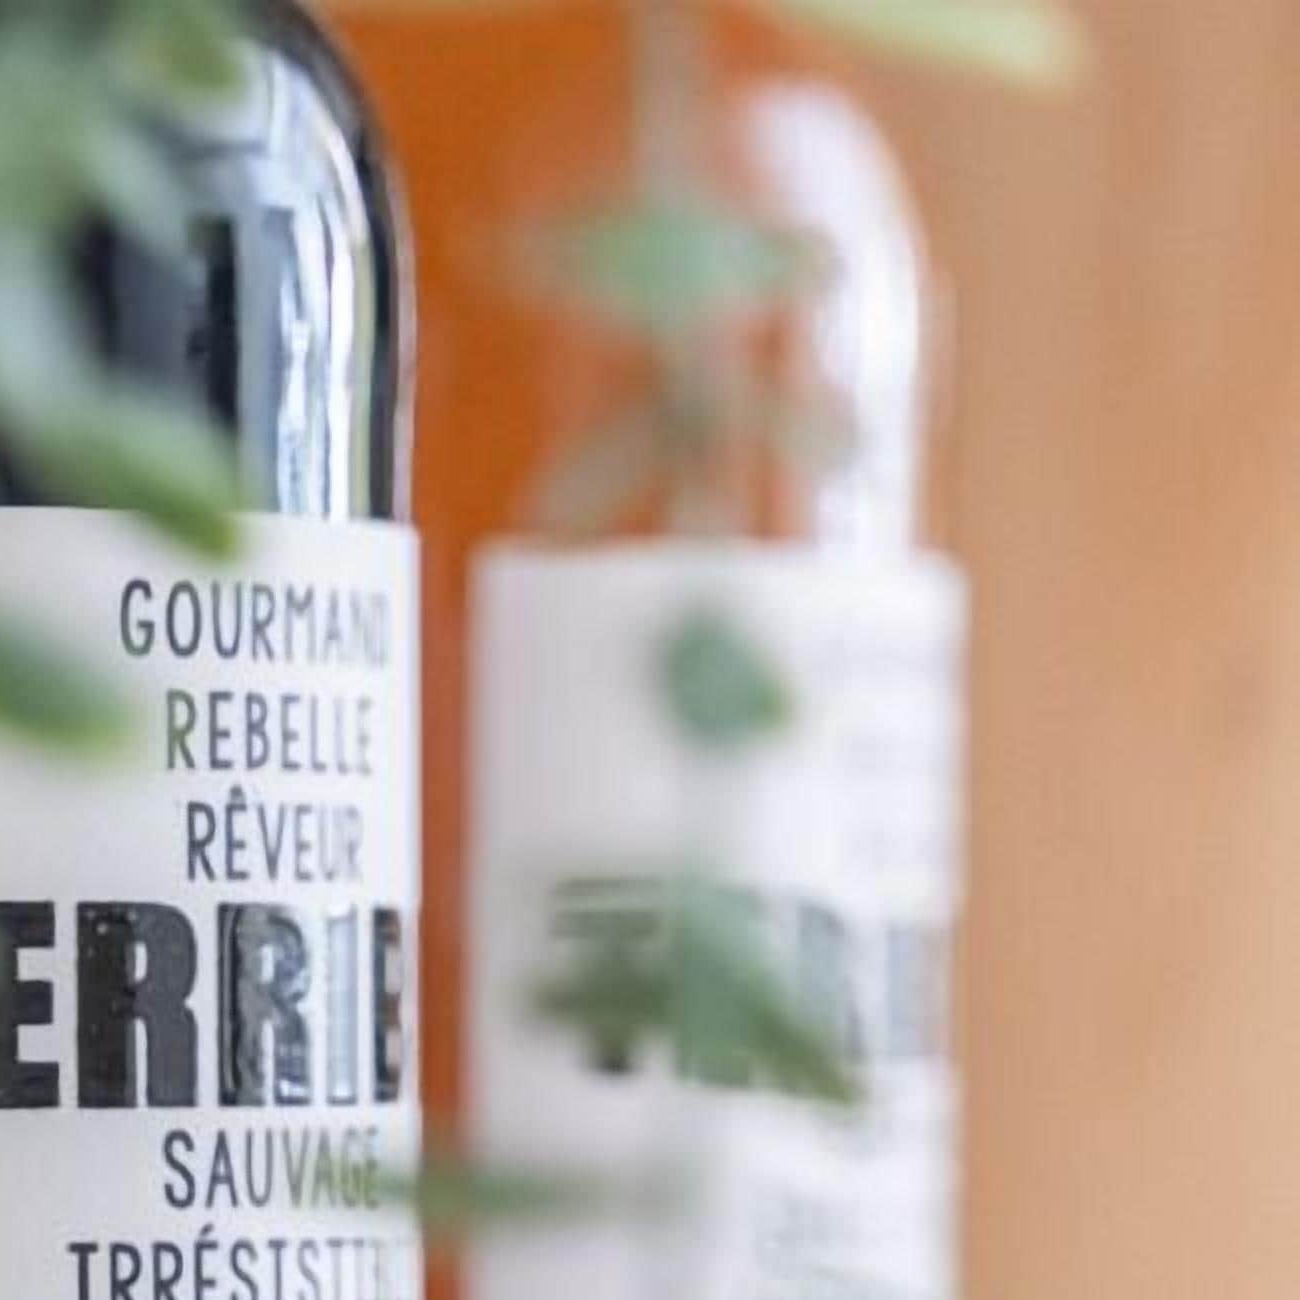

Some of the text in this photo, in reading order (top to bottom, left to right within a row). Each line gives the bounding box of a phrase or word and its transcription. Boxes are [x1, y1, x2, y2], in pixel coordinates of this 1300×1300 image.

[165, 688, 374, 777] REBELLE
[185, 784, 364, 884] RÊVEUR
[163, 1124, 379, 1209] SAUVAGE
